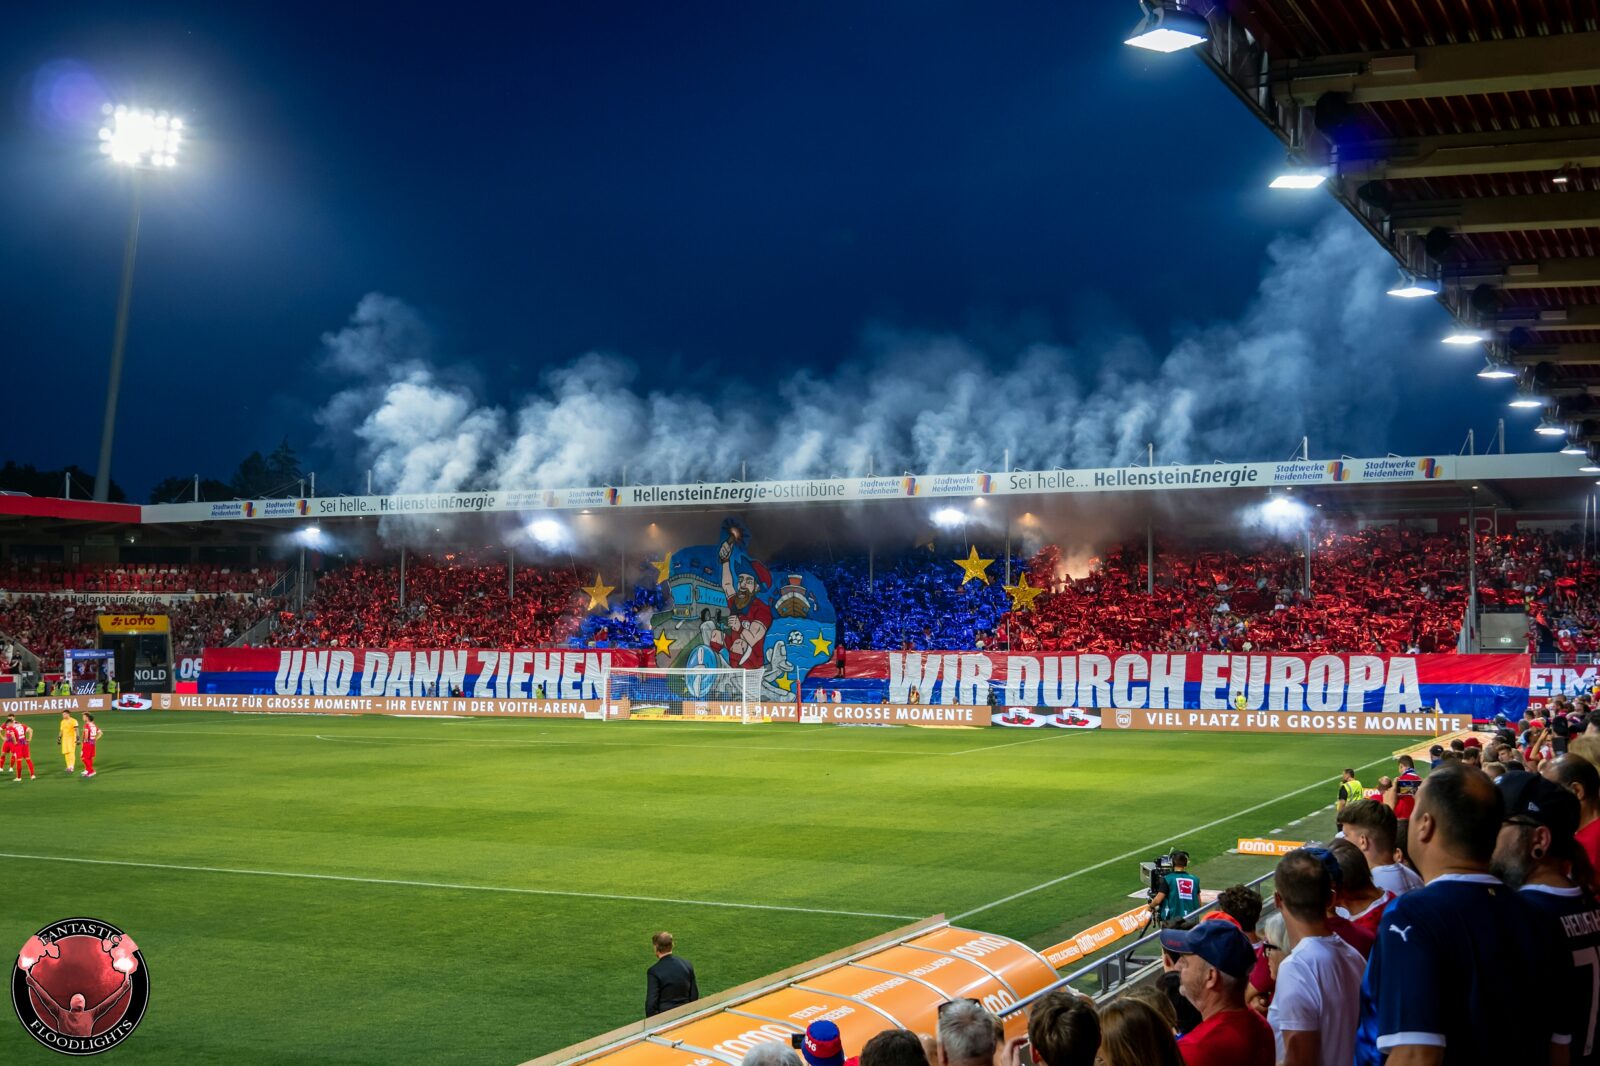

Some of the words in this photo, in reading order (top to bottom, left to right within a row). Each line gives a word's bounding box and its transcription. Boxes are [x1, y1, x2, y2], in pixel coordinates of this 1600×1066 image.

[1276, 463, 1325, 472] Stadtwerke
[1366, 460, 1416, 470] Stadtwerke
[1009, 474, 1032, 490] Sei
[1036, 470, 1089, 488] helle...
[1094, 466, 1258, 487] HellensteinEnergie
[1274, 472, 1323, 481] Heidenheim
[1363, 469, 1414, 478] Heidenheim
[860, 479, 900, 488] Stadtwerke
[934, 476, 976, 485] Stadtwerke
[633, 480, 845, 503] HellensteinEnergie-Osttribüne
[858, 487, 899, 495] Heidenheim
[931, 485, 974, 493] Heidenheim
[212, 503, 242, 511] Stadtwerke
[265, 501, 296, 509] Stadtwerke
[319, 499, 337, 513] Sei
[339, 498, 377, 513] helle...
[380, 493, 495, 511] HellensteinEnergie
[211, 509, 241, 517] Heidenheim
[264, 508, 295, 516] Heidenheim
[124, 617, 156, 626] LOTTO
[274, 650, 355, 696] UND
[360, 650, 468, 698] DANN
[473, 650, 612, 700] ZIEHEN
[888, 652, 993, 706] WIR
[1005, 653, 1187, 708] DURCH
[1200, 654, 1423, 714] EUROPA
[2, 698, 79, 712] VOITH-ARENA
[179, 696, 201, 708] VIEL
[206, 696, 238, 708] PLATZ
[241, 695, 263, 708] FÜR
[266, 697, 310, 709] GROSSE
[314, 698, 372, 710] MOMENTE
[386, 699, 407, 711] IHR
[411, 700, 448, 712] EVENT
[452, 700, 466, 712] IN
[469, 701, 495, 713] DER
[498, 701, 587, 714] VOITH-ARENA
[719, 704, 750, 718] VIEL
[754, 705, 796, 718] PLATZ
[801, 704, 828, 719] FÜR
[833, 706, 891, 720] GROSSE
[896, 708, 973, 722] MOMENTE
[1146, 712, 1183, 726] VIEL
[1188, 713, 1240, 727] PLATZ
[1246, 711, 1280, 728] FÜR
[1287, 714, 1358, 730] GROSSE
[1364, 716, 1461, 732] MOMENTE
[1239, 841, 1275, 853] roma
